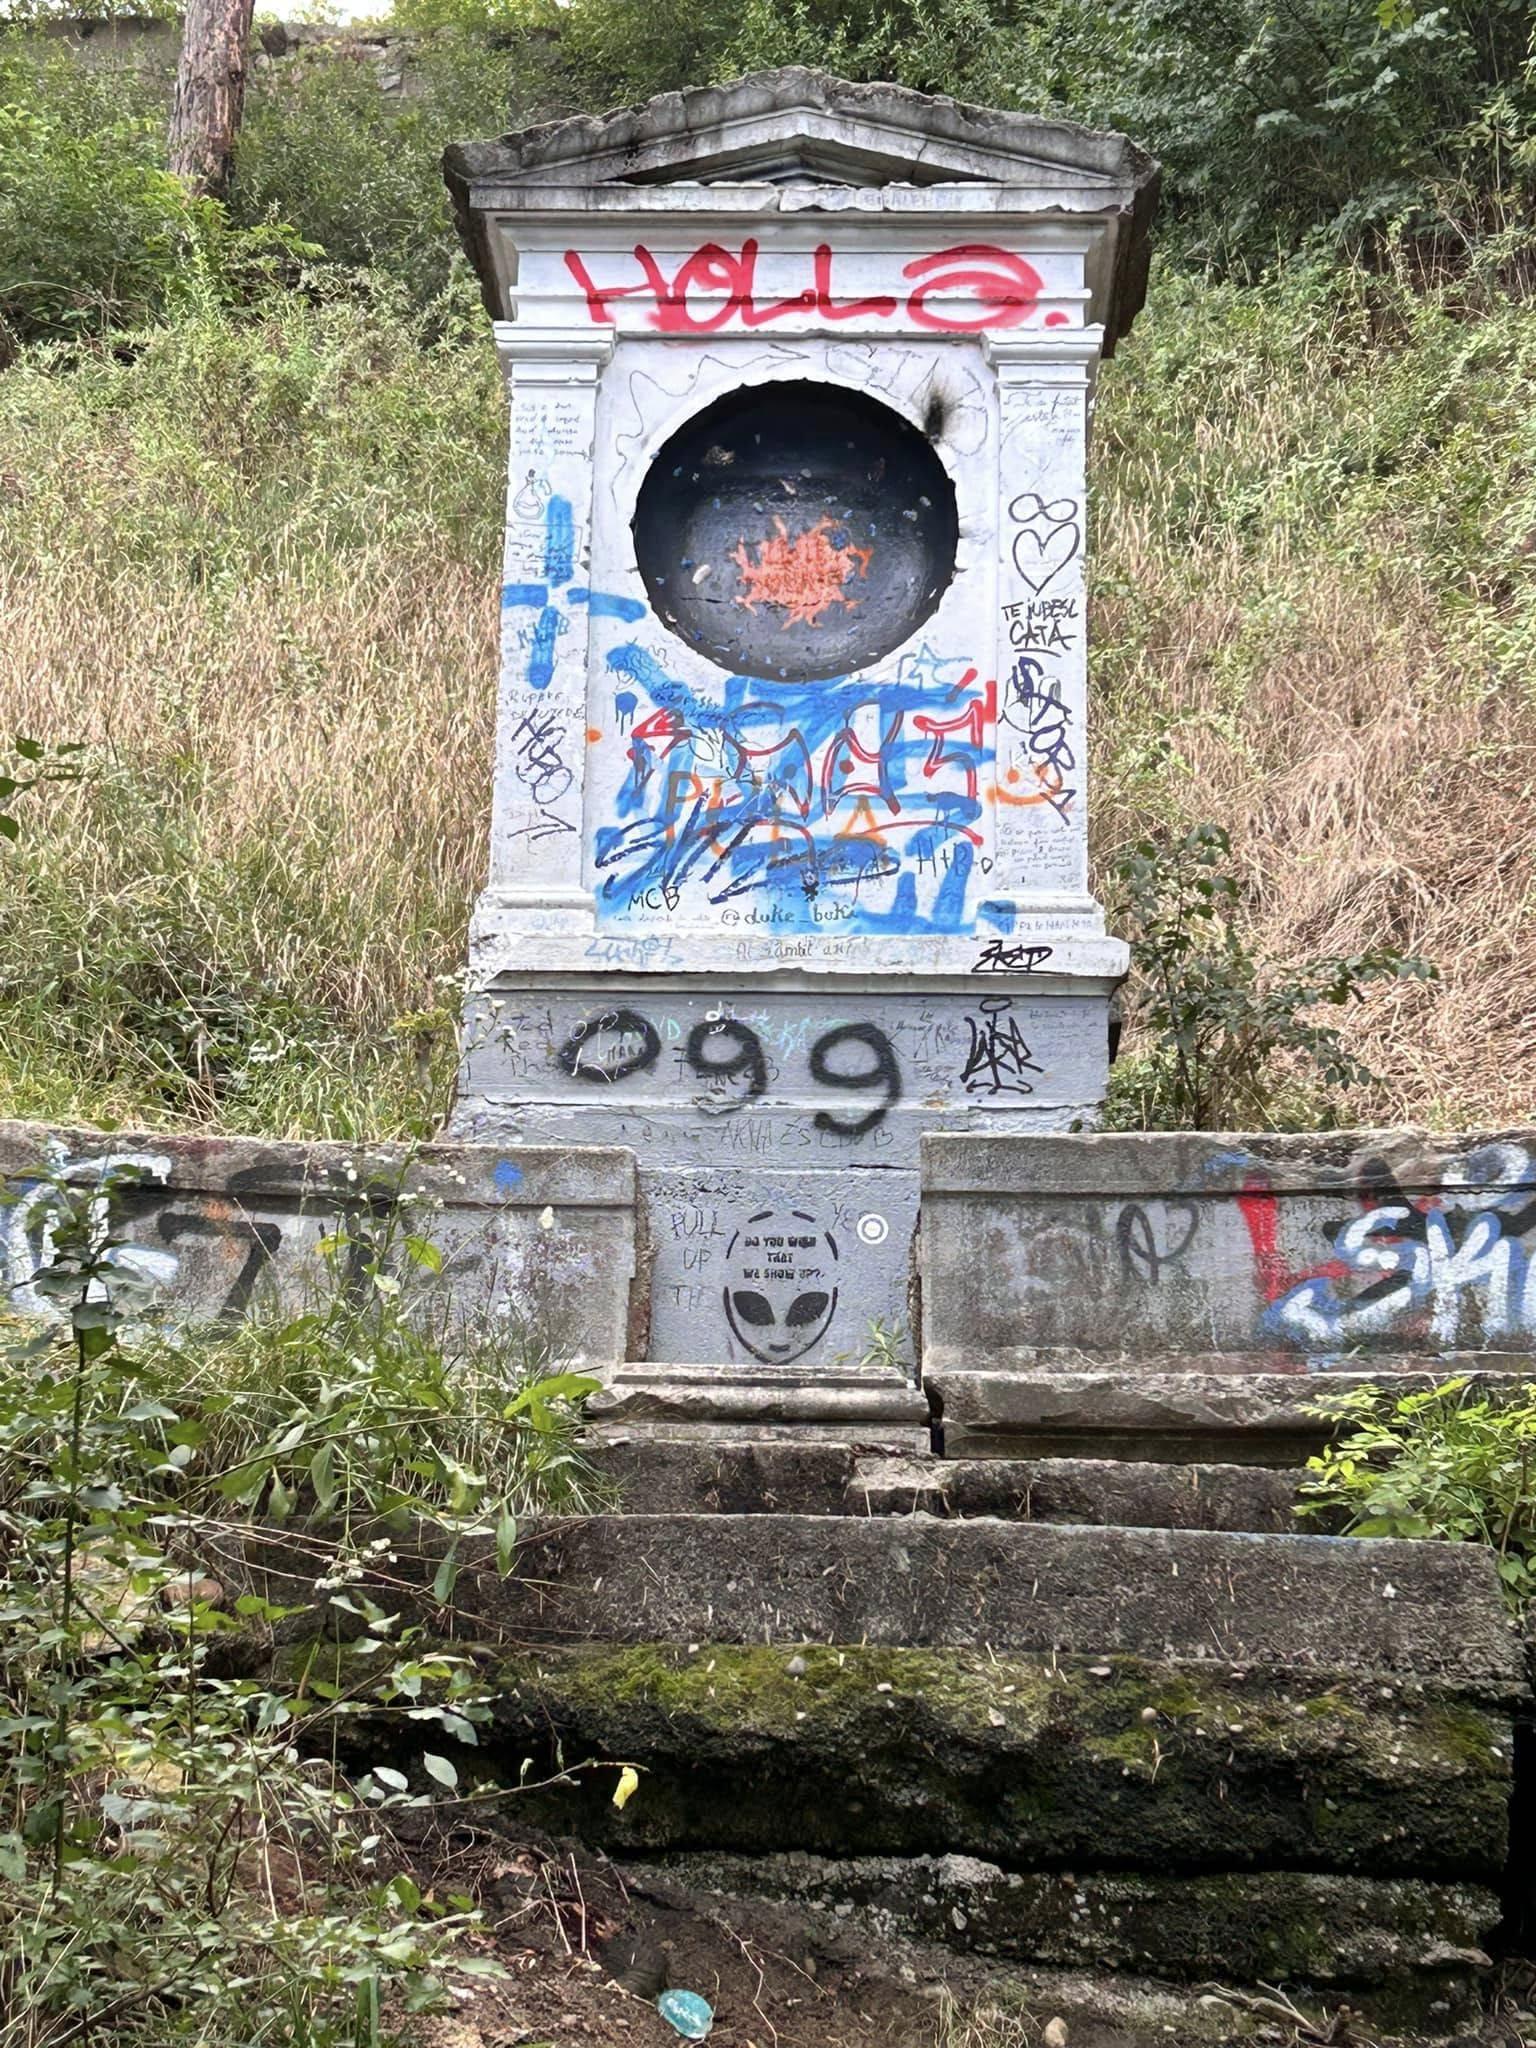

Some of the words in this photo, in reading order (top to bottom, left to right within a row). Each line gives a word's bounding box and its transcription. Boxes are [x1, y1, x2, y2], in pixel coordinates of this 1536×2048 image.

[1001, 601, 1024, 621] TE
[763, 1236, 785, 1248] YOU
[767, 1252, 793, 1264] THAT
[764, 1268, 795, 1280] SHOW
